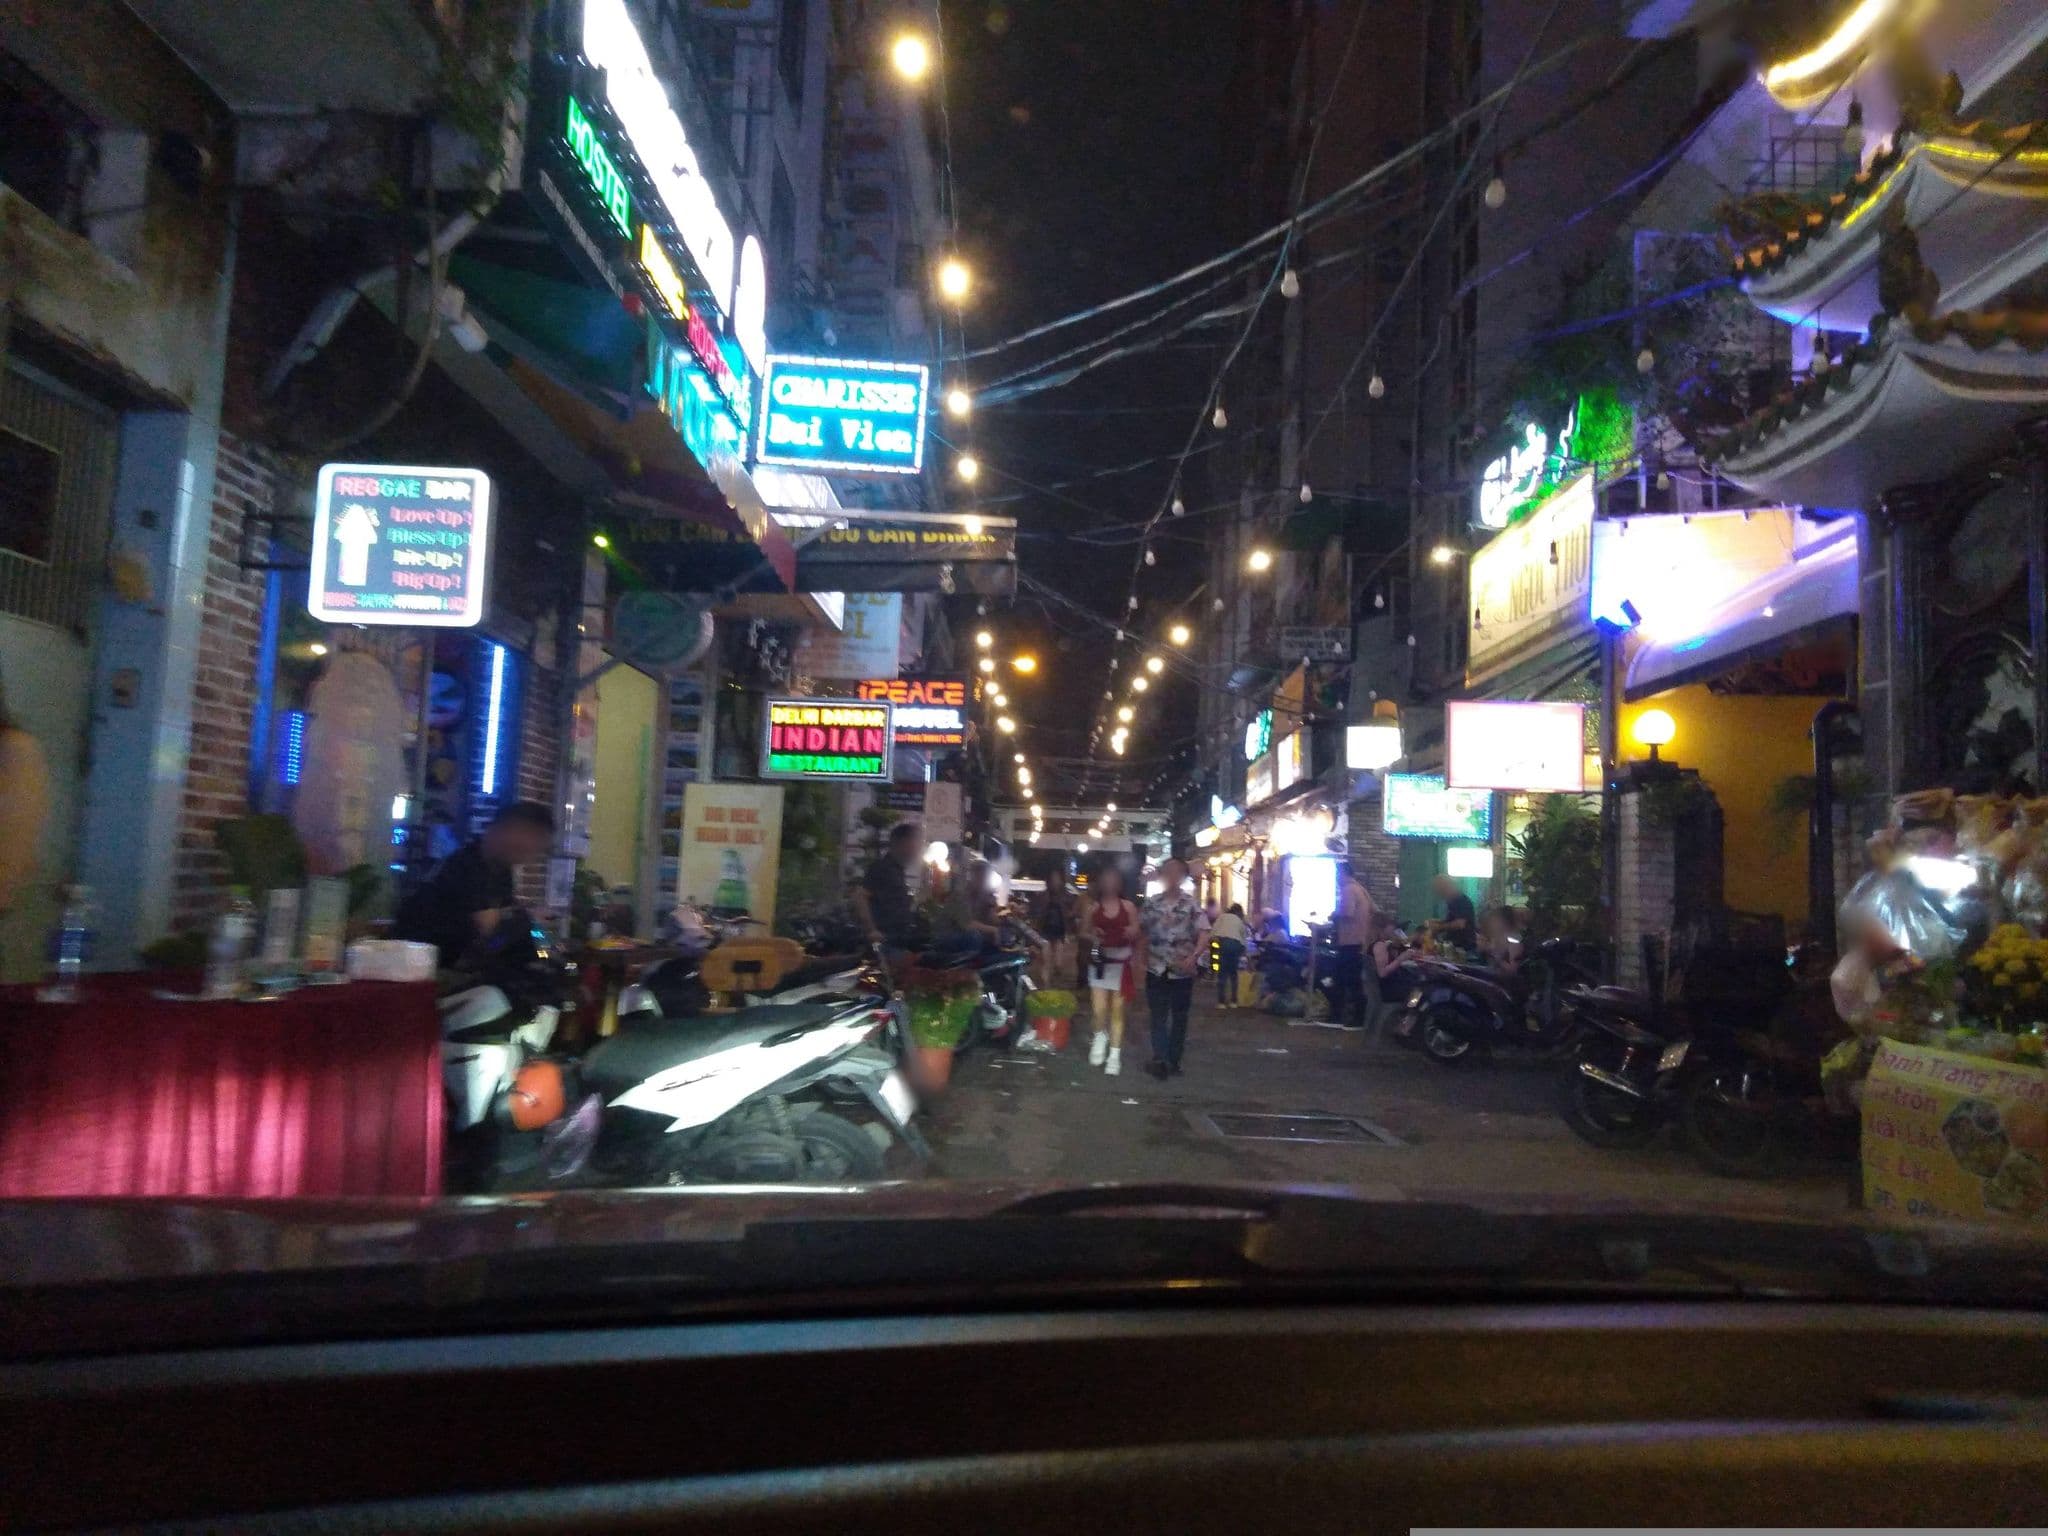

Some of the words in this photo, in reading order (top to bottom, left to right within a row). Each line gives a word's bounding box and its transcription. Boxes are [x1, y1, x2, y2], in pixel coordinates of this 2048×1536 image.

[566, 95, 633, 241] HOSTEL
[336, 477, 420, 498] REGGAE
[425, 480, 470, 500] BAR
[391, 506, 434, 523] Love
[435, 508, 463, 527] Up
[388, 528, 435, 544] Bless
[436, 530, 463, 548] Up
[772, 726, 882, 752] INDIAN
[771, 754, 882, 773] RESTAURANT
